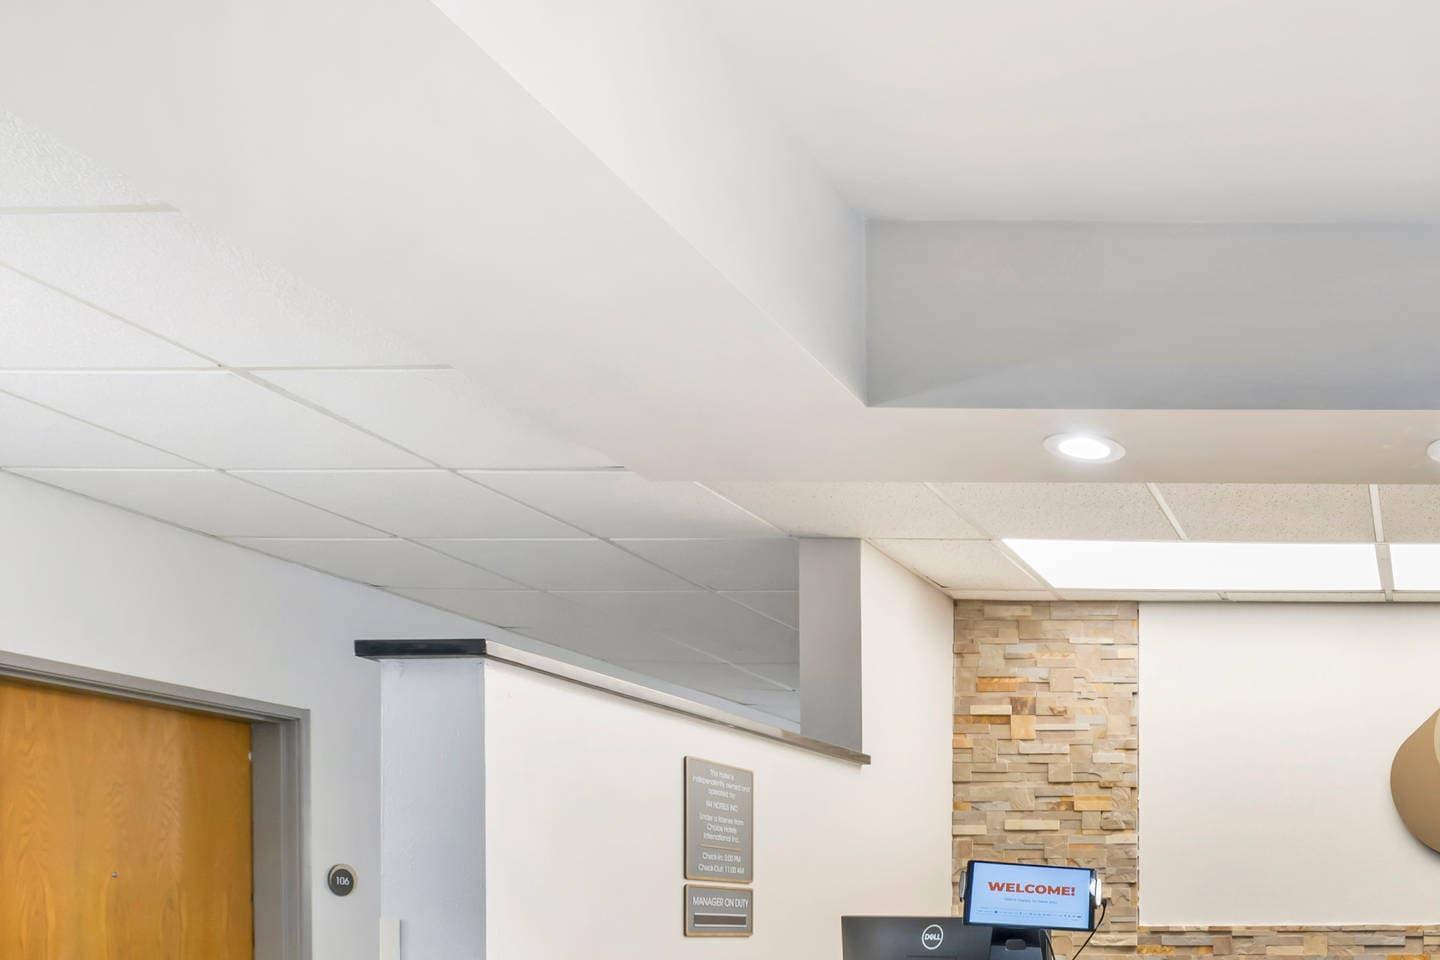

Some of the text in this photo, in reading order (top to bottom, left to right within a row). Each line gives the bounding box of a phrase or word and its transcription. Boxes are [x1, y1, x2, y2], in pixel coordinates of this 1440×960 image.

[336, 876, 350, 886] 106
[988, 881, 1076, 897] WELCOME!
[692, 895, 749, 910] MANAGER ON DUTY
